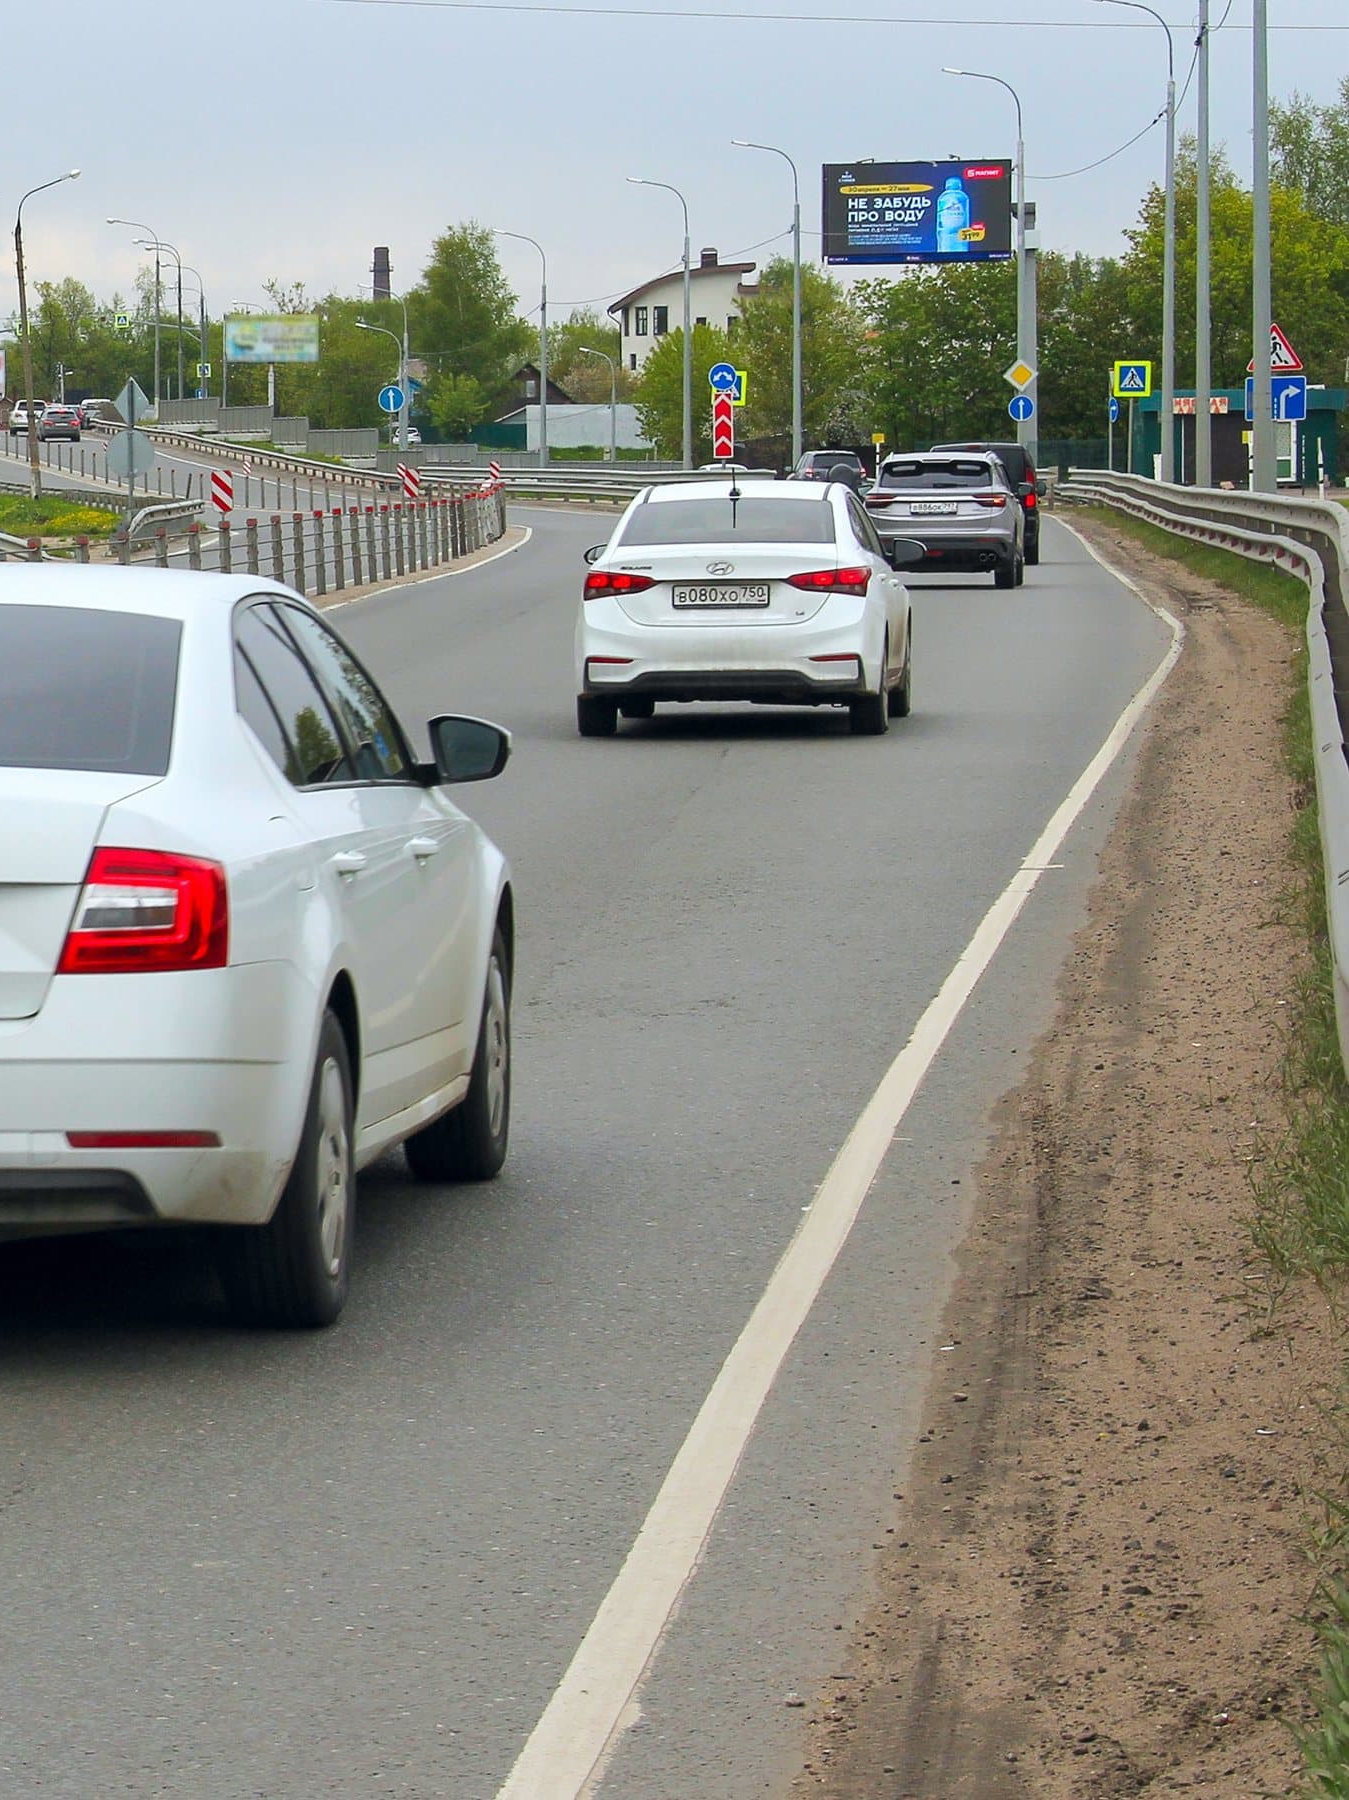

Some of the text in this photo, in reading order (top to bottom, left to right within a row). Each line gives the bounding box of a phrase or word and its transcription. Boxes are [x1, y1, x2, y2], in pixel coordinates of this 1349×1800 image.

[848, 196, 931, 209] НЕ ЗАБУДЬ
[848, 209, 925, 222] ПРО ВОДУ
[679, 586, 765, 603] В080ХО 750
